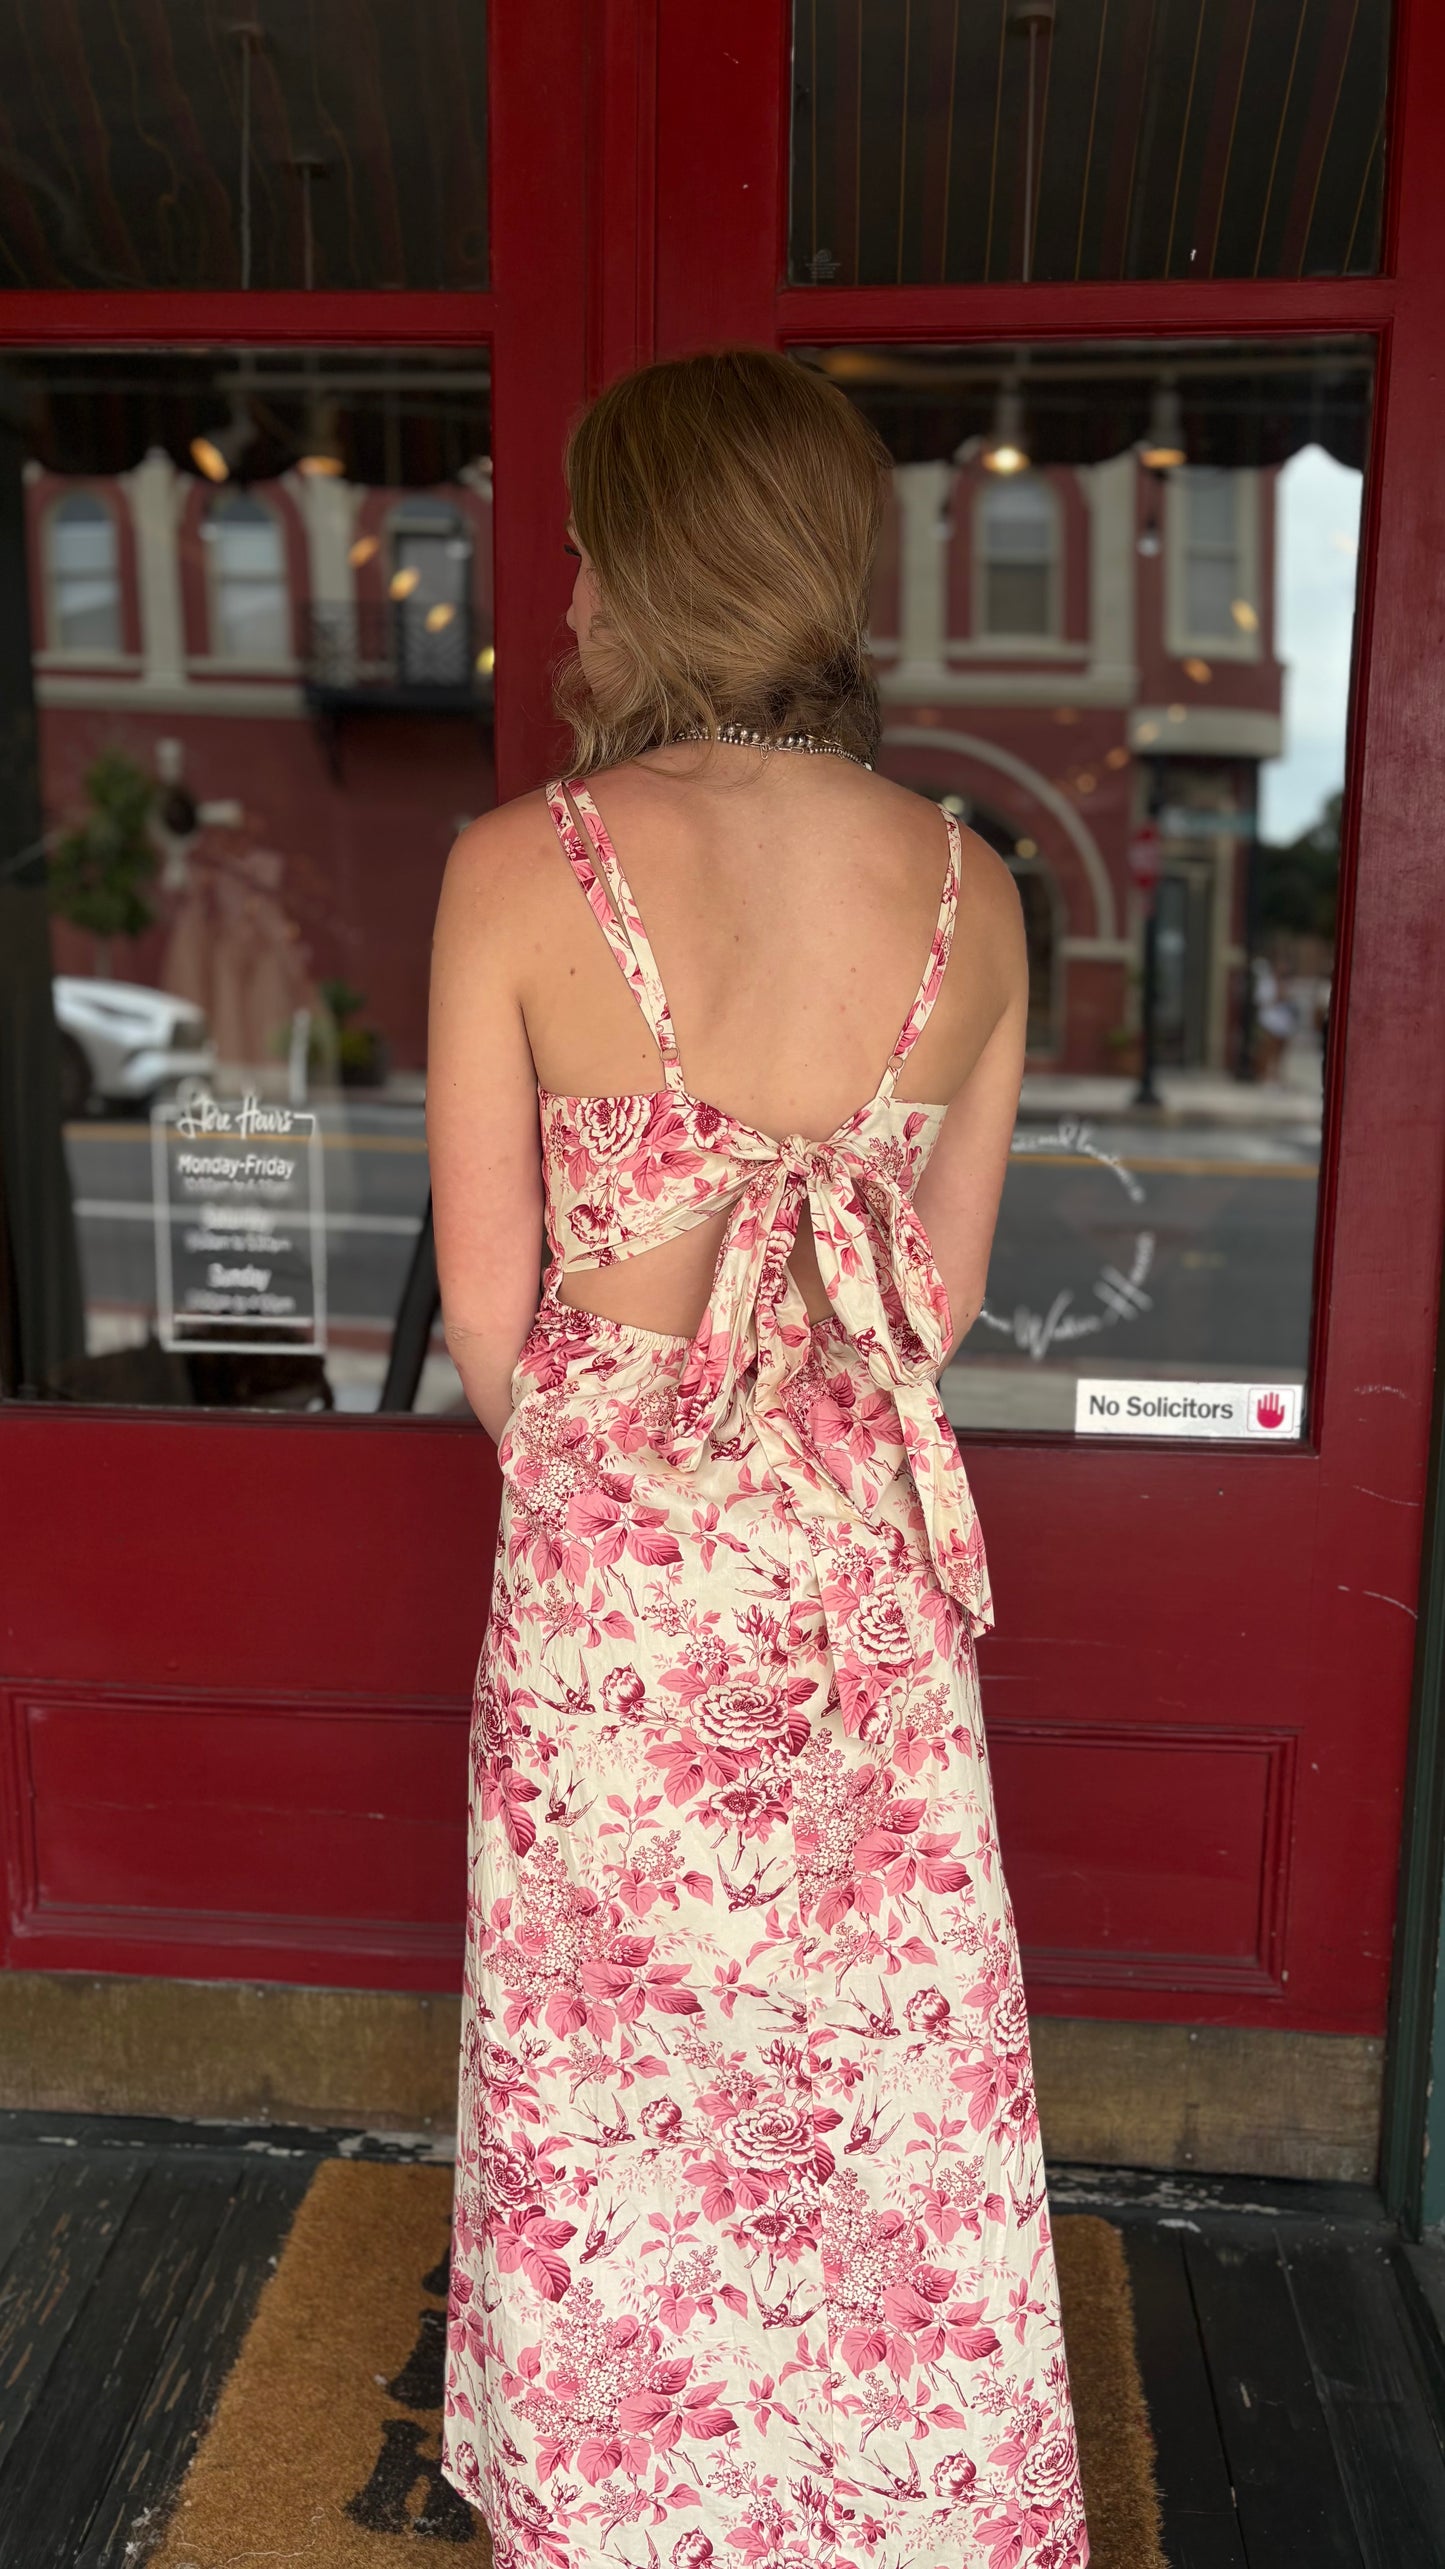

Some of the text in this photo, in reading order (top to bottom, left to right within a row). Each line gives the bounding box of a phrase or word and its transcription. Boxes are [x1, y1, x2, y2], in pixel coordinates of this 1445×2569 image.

[178, 1153, 295, 1180] Monday-Friday
[1089, 1395, 1234, 1420] No Solicitors
